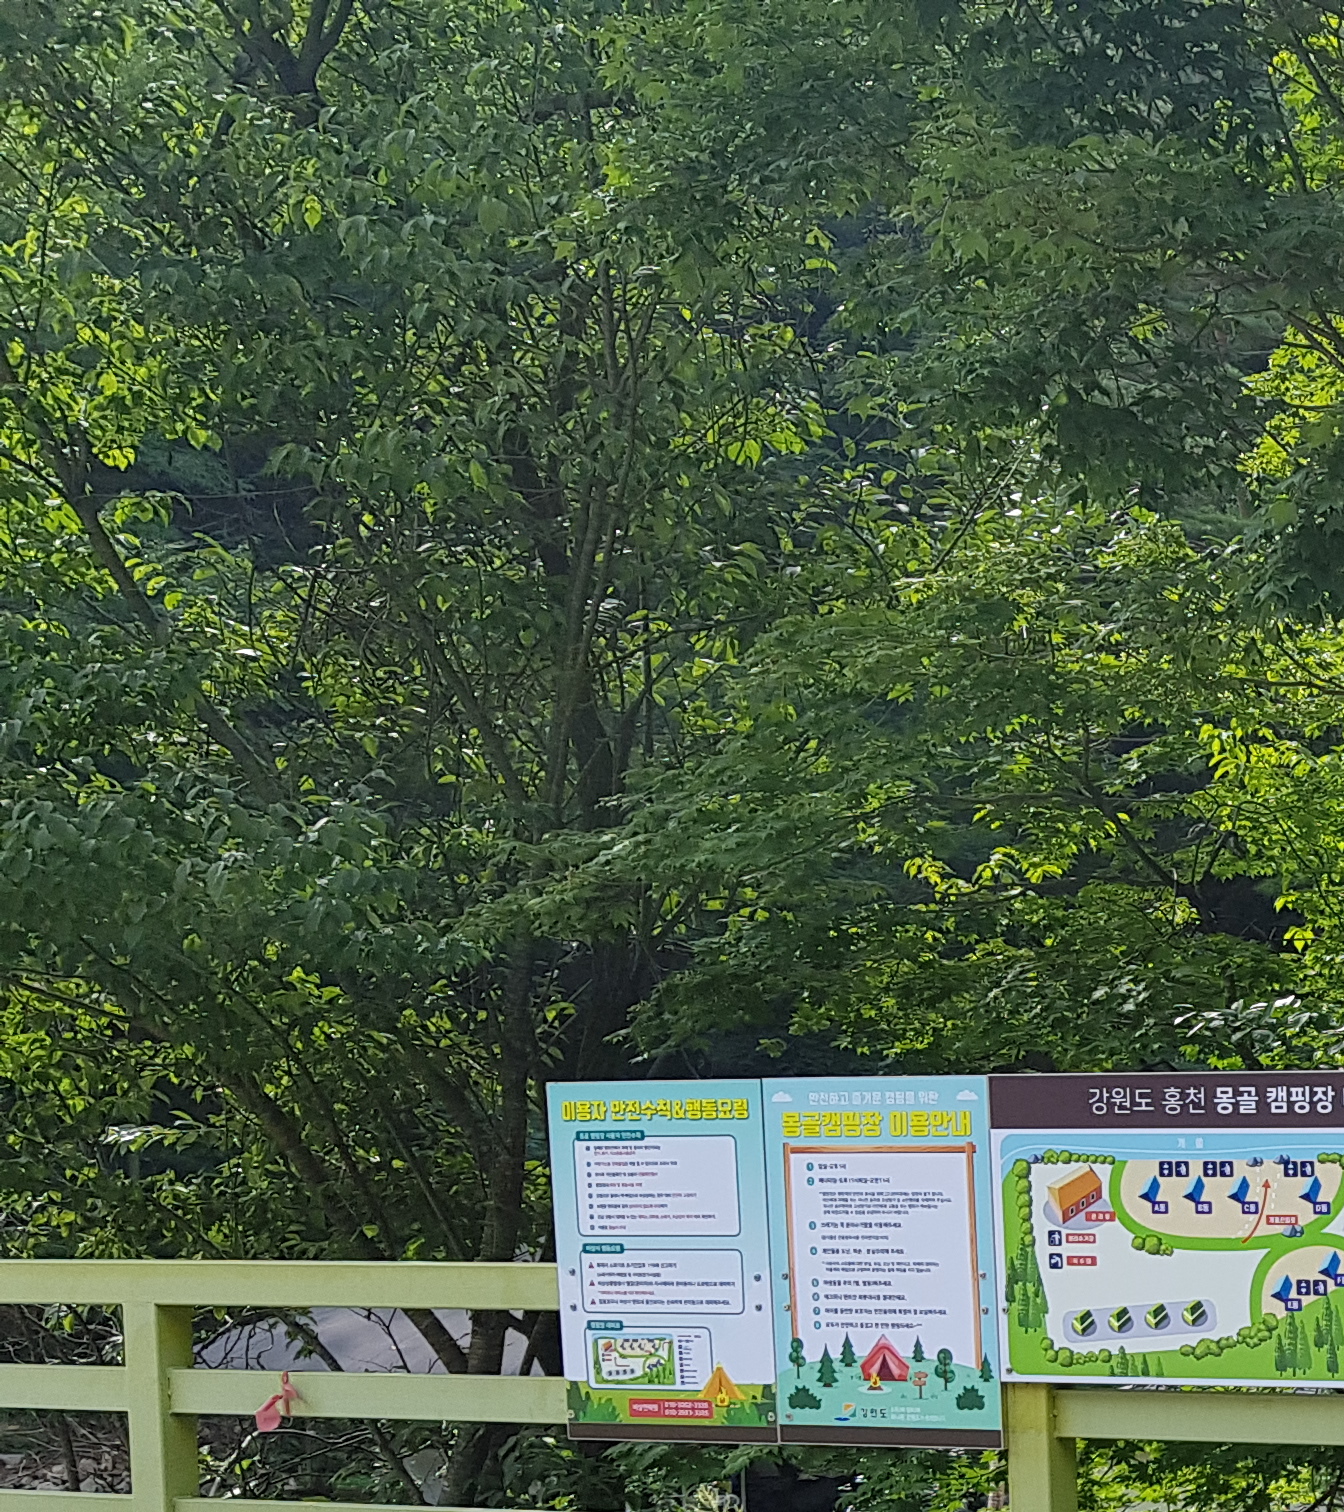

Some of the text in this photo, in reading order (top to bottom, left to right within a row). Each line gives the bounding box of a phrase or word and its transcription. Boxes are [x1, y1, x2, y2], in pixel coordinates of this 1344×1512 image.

[561, 1097, 750, 1122] 이용자 안전수칙&행동요령
[808, 1090, 939, 1106] 안전하고 즐거운 캠핑을 위한
[1087, 1086, 1155, 1115] 강원도
[1161, 1085, 1206, 1115] 홍천
[1213, 1085, 1259, 1115] 몽골
[1265, 1084, 1335, 1114] 캠핑장
[781, 1109, 972, 1138] 몽골캠핑장 이용안내
